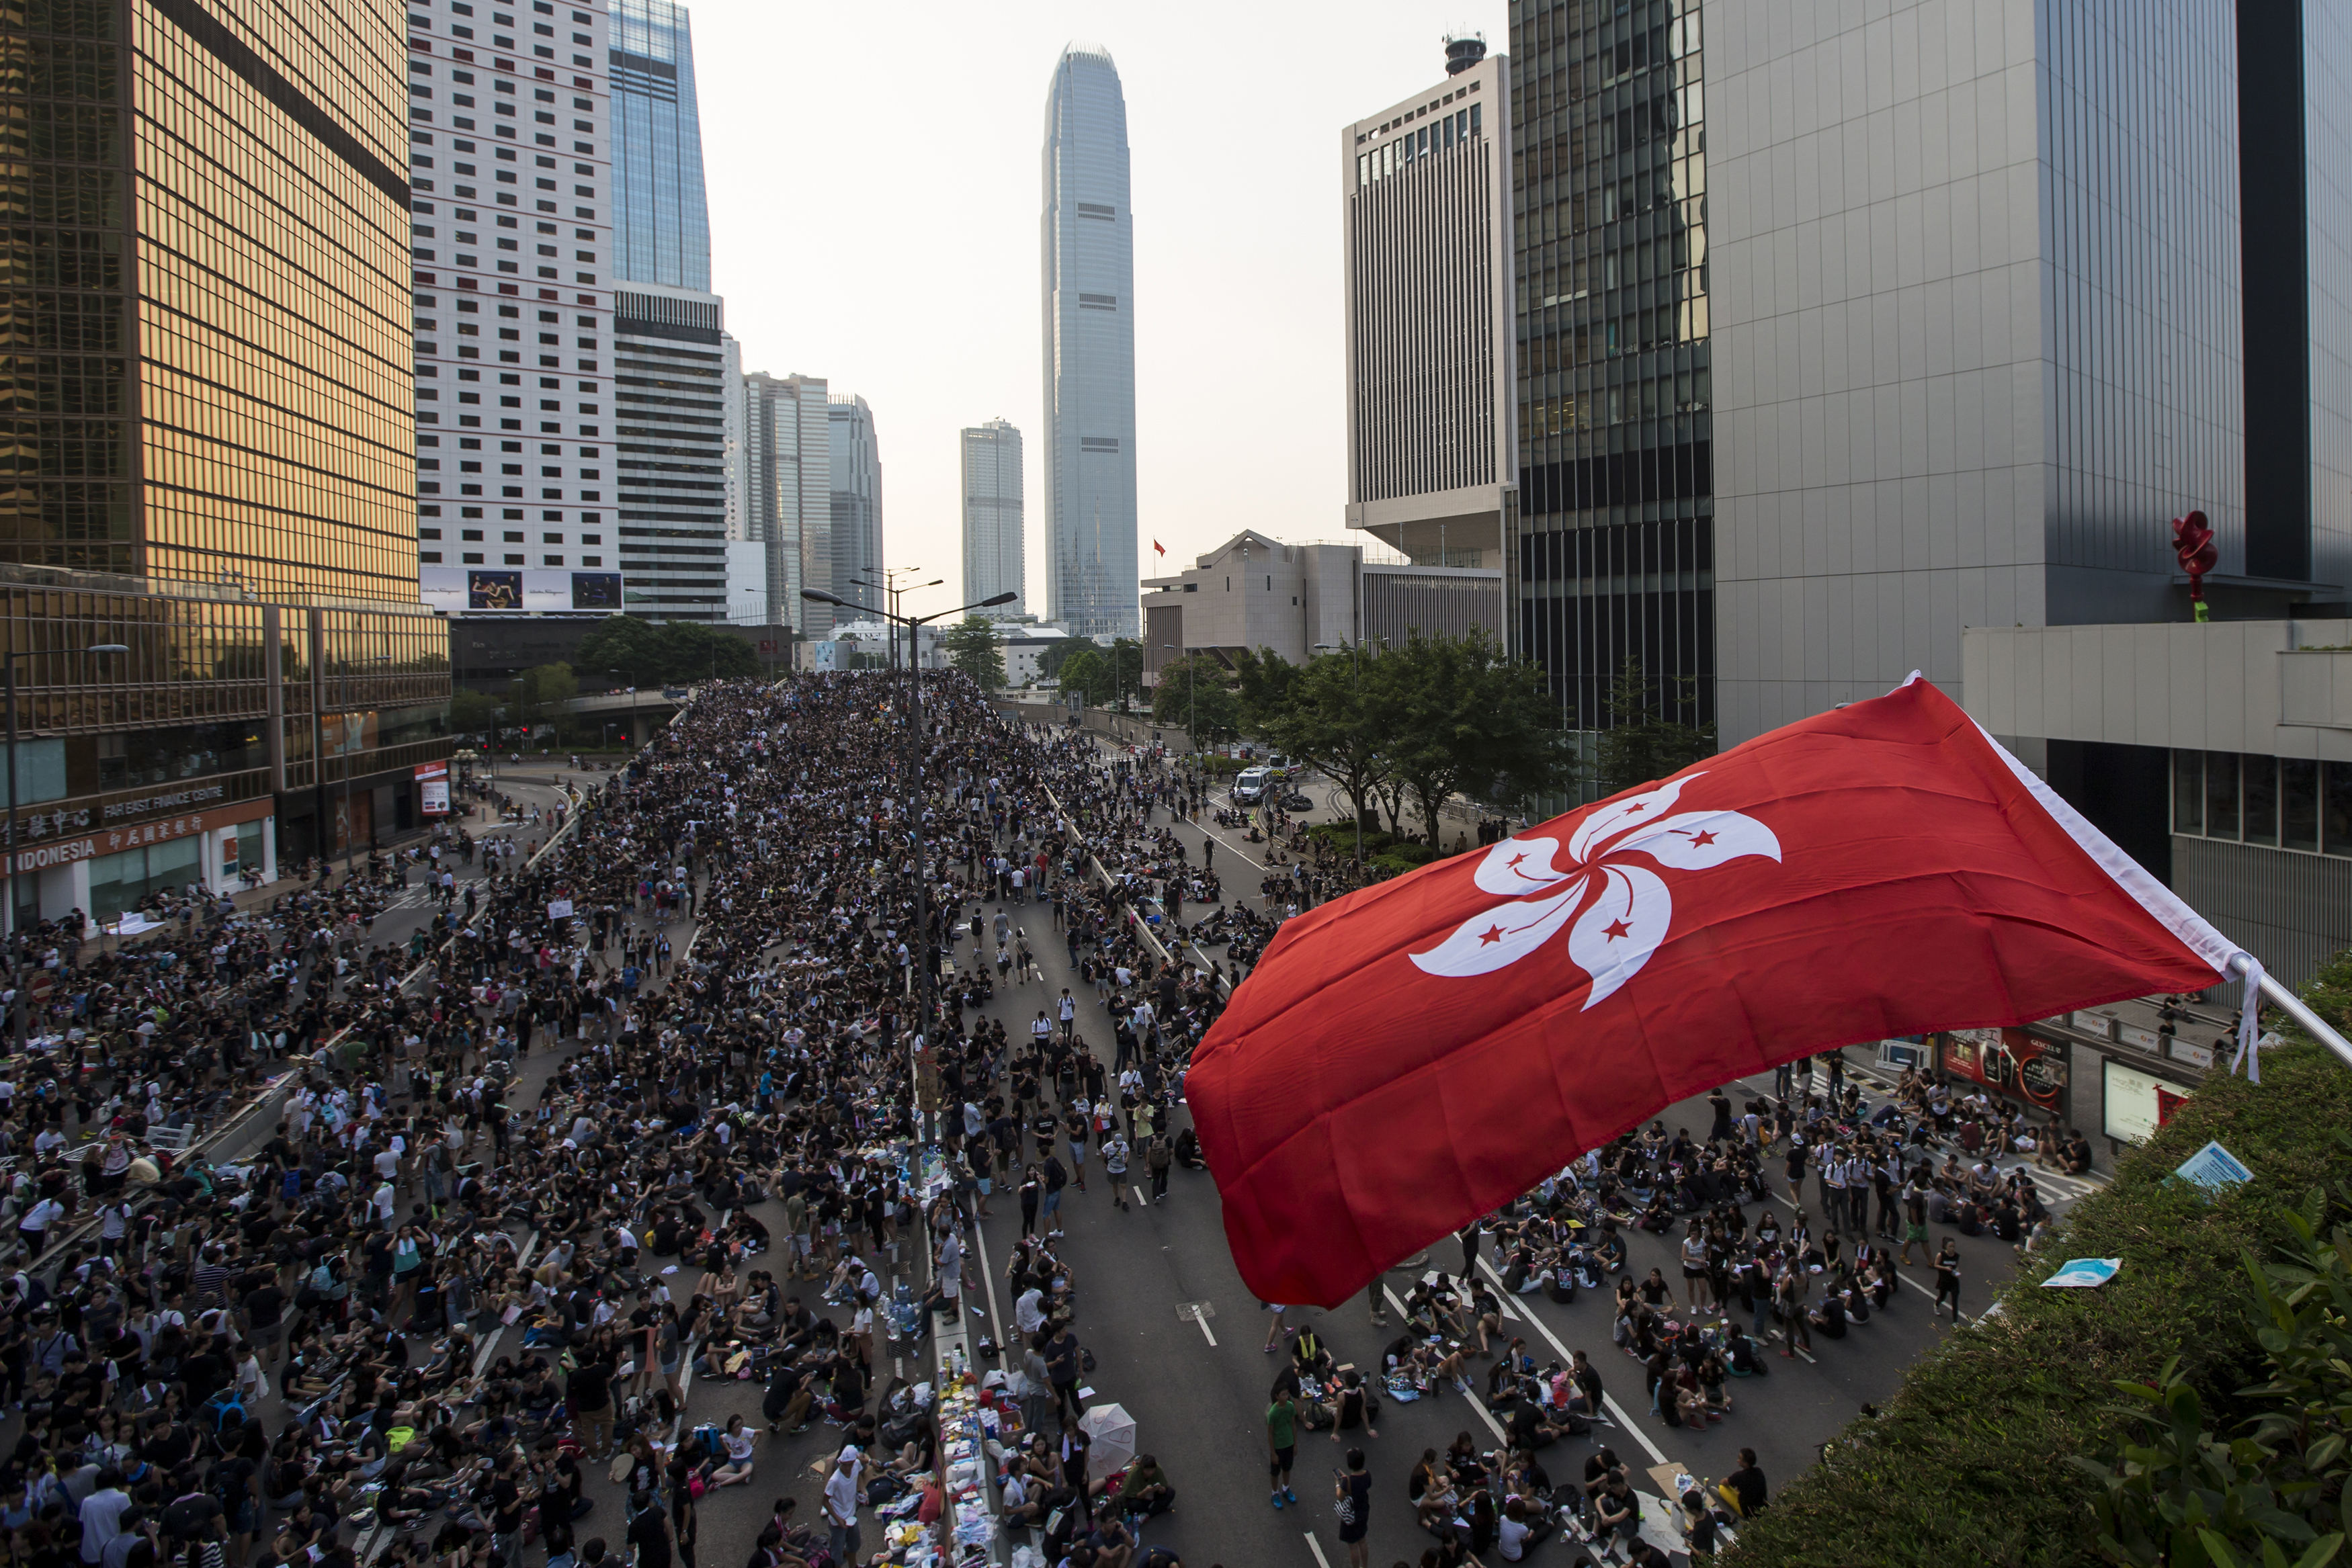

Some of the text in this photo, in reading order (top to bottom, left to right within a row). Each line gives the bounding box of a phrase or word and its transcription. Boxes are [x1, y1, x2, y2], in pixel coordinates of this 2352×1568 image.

[103, 786, 224, 818] FAR EAST FINANCE CENTRE
[109, 816, 203, 850] 印尼國家銀行
